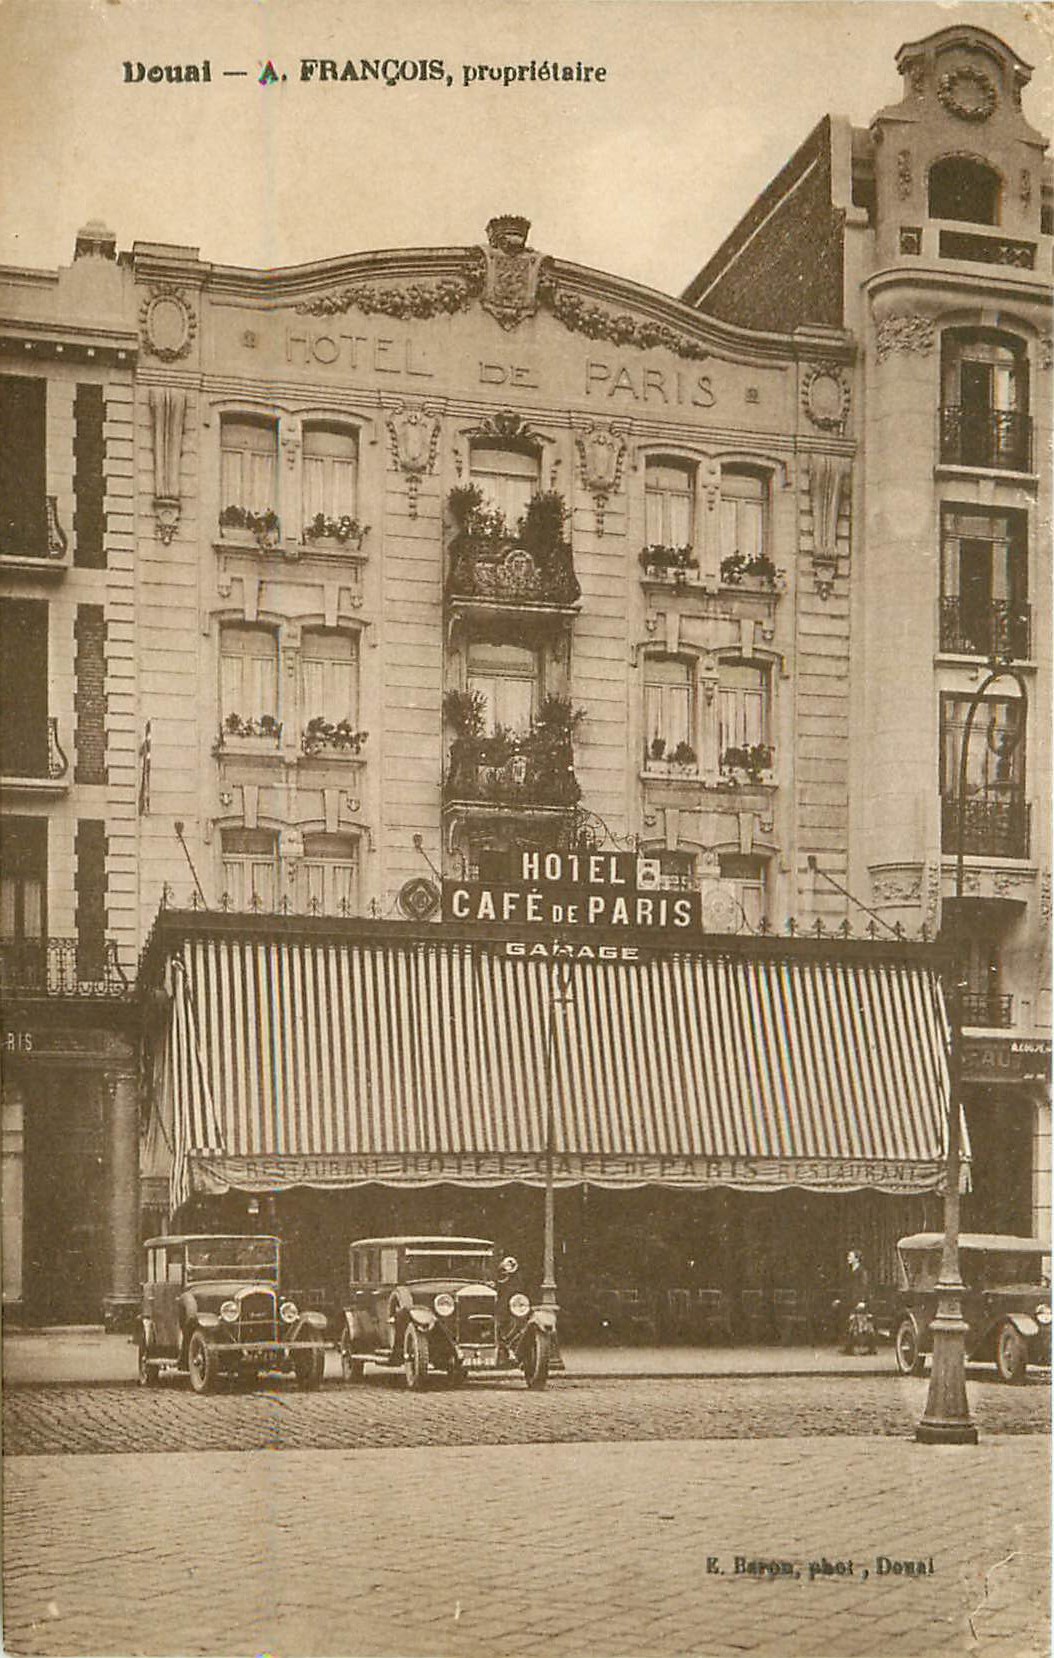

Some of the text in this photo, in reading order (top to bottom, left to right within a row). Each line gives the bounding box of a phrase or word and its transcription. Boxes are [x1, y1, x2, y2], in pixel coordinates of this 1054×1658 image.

[287, 329, 718, 408] HOTEL DE PARIS
[522, 852, 626, 885] HOTEL
[452, 889, 692, 927] CAFÉ DE PARIS
[505, 941, 640, 960] GARAGE
